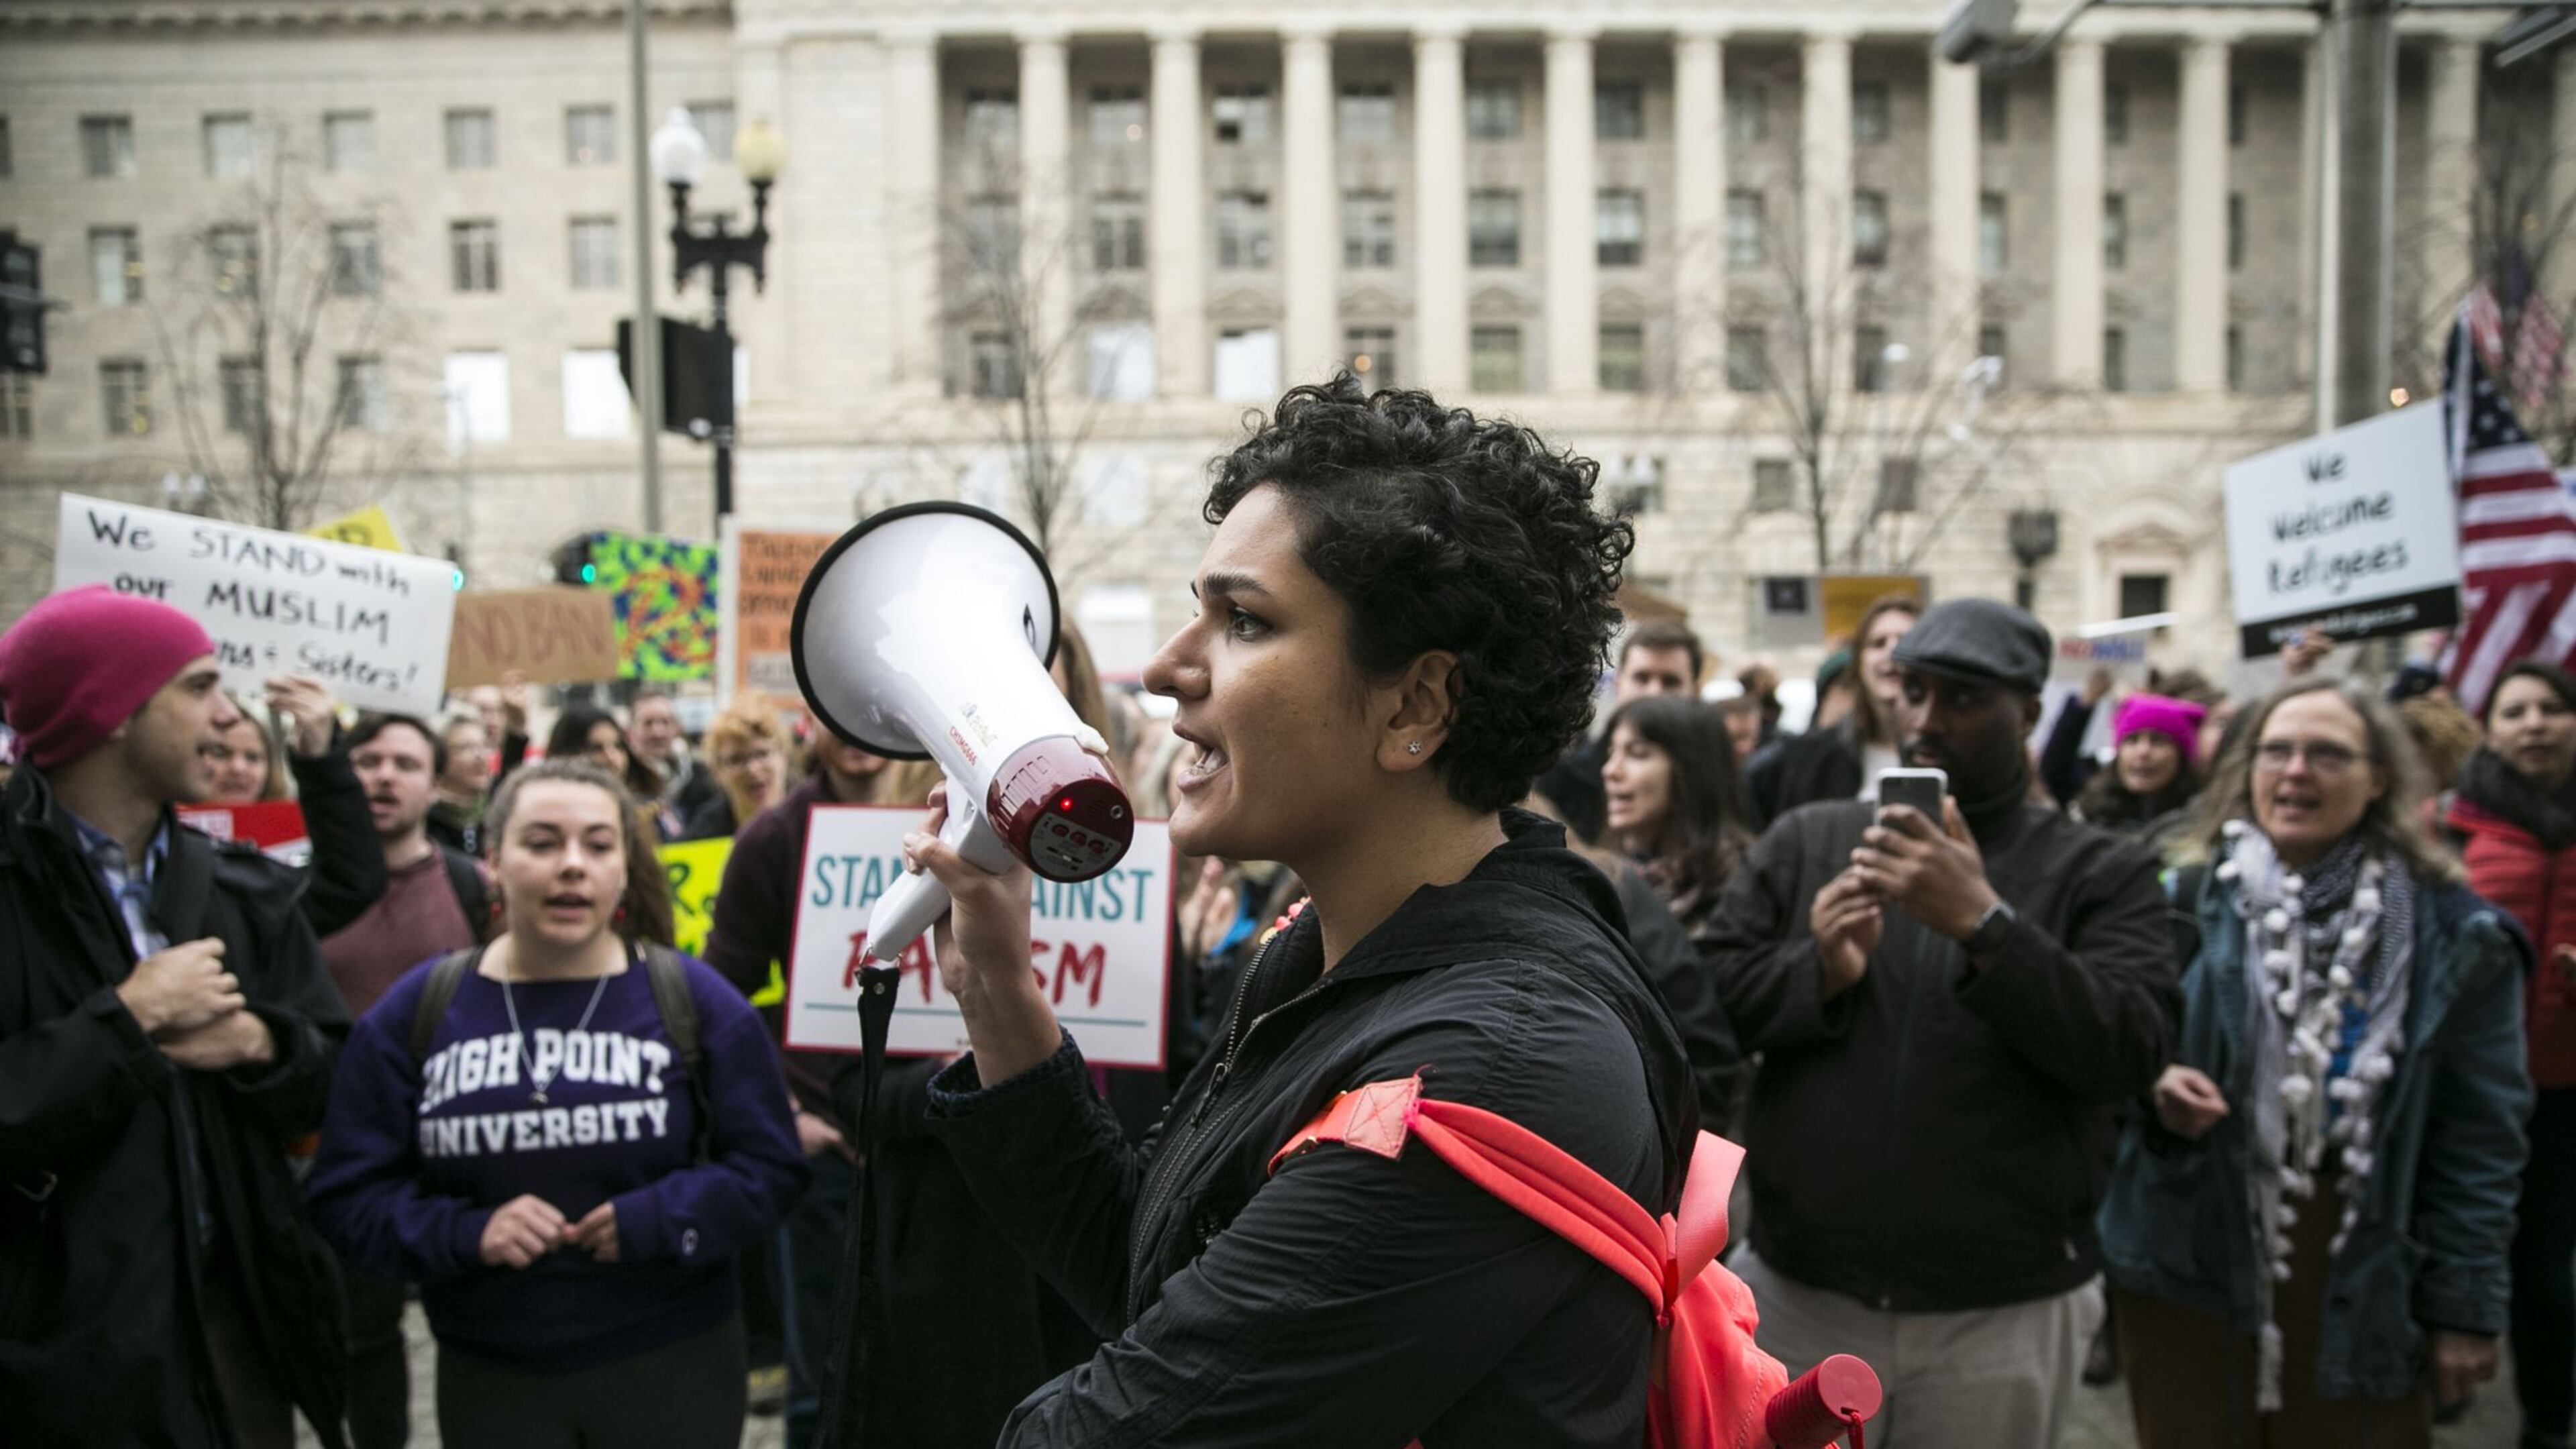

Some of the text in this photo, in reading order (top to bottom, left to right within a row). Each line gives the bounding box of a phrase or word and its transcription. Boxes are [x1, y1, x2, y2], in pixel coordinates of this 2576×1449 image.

[2304, 451, 2345, 482] We
[87, 508, 156, 551] We
[190, 527, 326, 578] STAND
[2270, 491, 2395, 542] Welcome
[207, 580, 388, 644] MUSLIM
[812, 855, 1154, 921] STA AINST
[419, 1028, 670, 1114] HIGH POINT
[419, 1097, 669, 1158] UNIVERSITY
